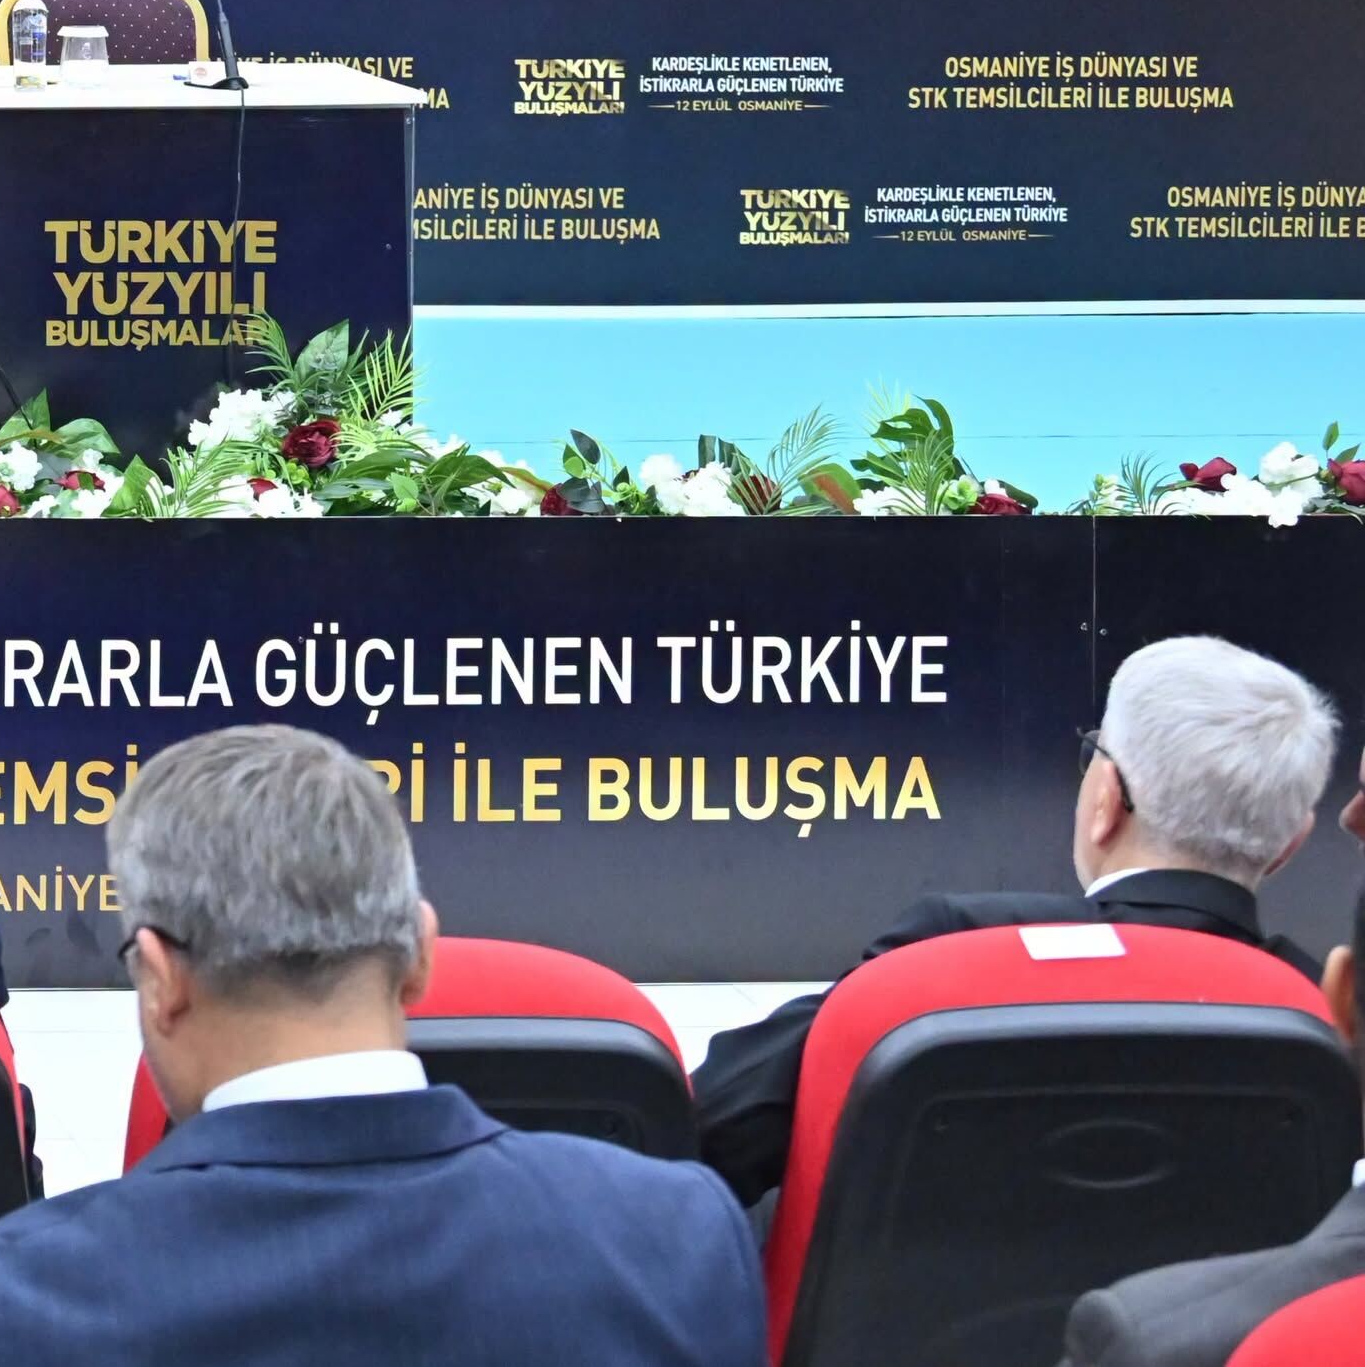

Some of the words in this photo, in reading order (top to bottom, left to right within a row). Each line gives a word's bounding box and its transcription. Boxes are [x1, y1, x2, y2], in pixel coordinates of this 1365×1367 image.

[652, 53, 741, 75] KARDEŞLİKLE
[742, 56, 833, 74] KENETLENEN,
[944, 50, 1051, 78] OSMANİYE
[1055, 50, 1075, 83] İŞ
[1079, 51, 1167, 78] DÜNYASI
[1172, 56, 1198, 78] VE
[639, 74, 716, 93] İSTİKRARLA
[716, 74, 788, 96] GÜÇLENEN
[789, 74, 844, 93] TÜRKİYE
[908, 87, 948, 109] STK
[952, 81, 1093, 109] TEMSİLCİLERİ
[1098, 81, 1130, 109] İLE
[1135, 86, 1234, 114] BULUŞMA
[675, 100, 691, 112] 12
[692, 97, 733, 112] EYLÜL
[737, 97, 803, 112] OSMANİYE
[480, 182, 500, 215] İŞ
[505, 182, 594, 210] DÜNYASI
[598, 187, 625, 209] VE
[876, 184, 965, 206] KARDEŞLİKLE
[966, 186, 1057, 203] KENETLENEN,
[1167, 180, 1272, 208] OSMANİYE
[1277, 180, 1296, 213] İŞ
[523, 213, 556, 241] İLE
[561, 217, 661, 245] BULUŞMA
[864, 205, 940, 224] İSTİKRARLA
[941, 204, 1012, 226] GÜÇLENEN
[1013, 204, 1069, 223] TÜRKİYE
[1129, 216, 1170, 238] STK
[1174, 211, 1314, 238] TEMSİLCİLERİ
[1319, 211, 1351, 238] İLE
[255, 622, 633, 726] GÜÇLENEN
[656, 619, 948, 704] TÜRKİYE
[452, 742, 562, 823] İLE
[587, 756, 942, 838] BULUŞMA
